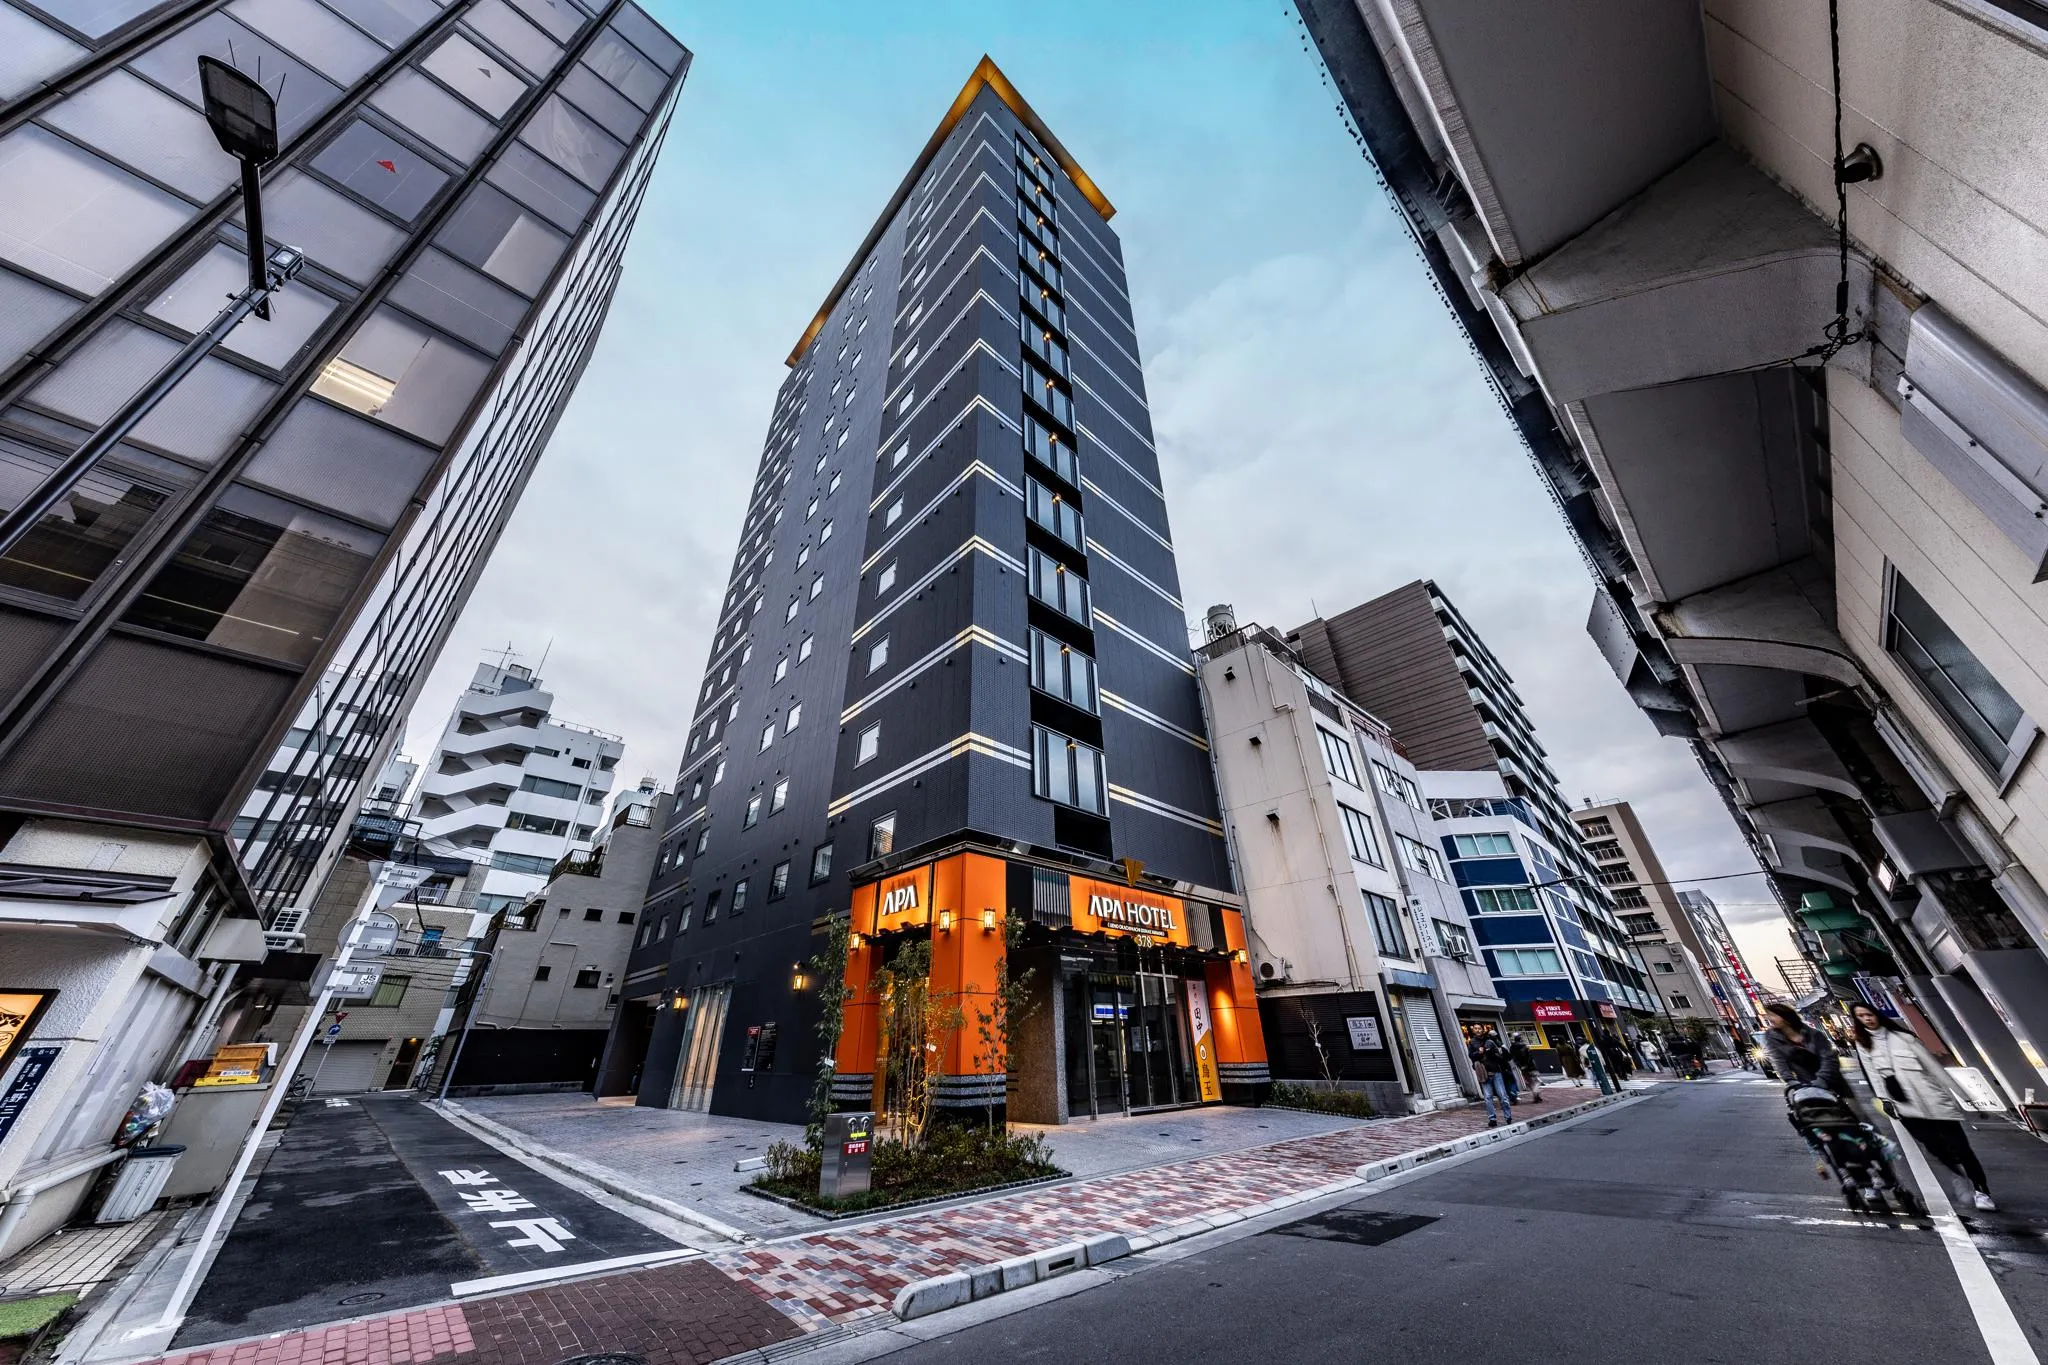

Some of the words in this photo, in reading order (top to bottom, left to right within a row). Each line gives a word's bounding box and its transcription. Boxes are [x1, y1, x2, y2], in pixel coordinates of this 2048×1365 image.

[882, 885, 916, 916] APA
[1090, 895, 1124, 921] APA
[1126, 902, 1177, 929] HOTEL
[1137, 934, 1153, 948] 378
[438, 1169, 576, 1253] 止まれ
